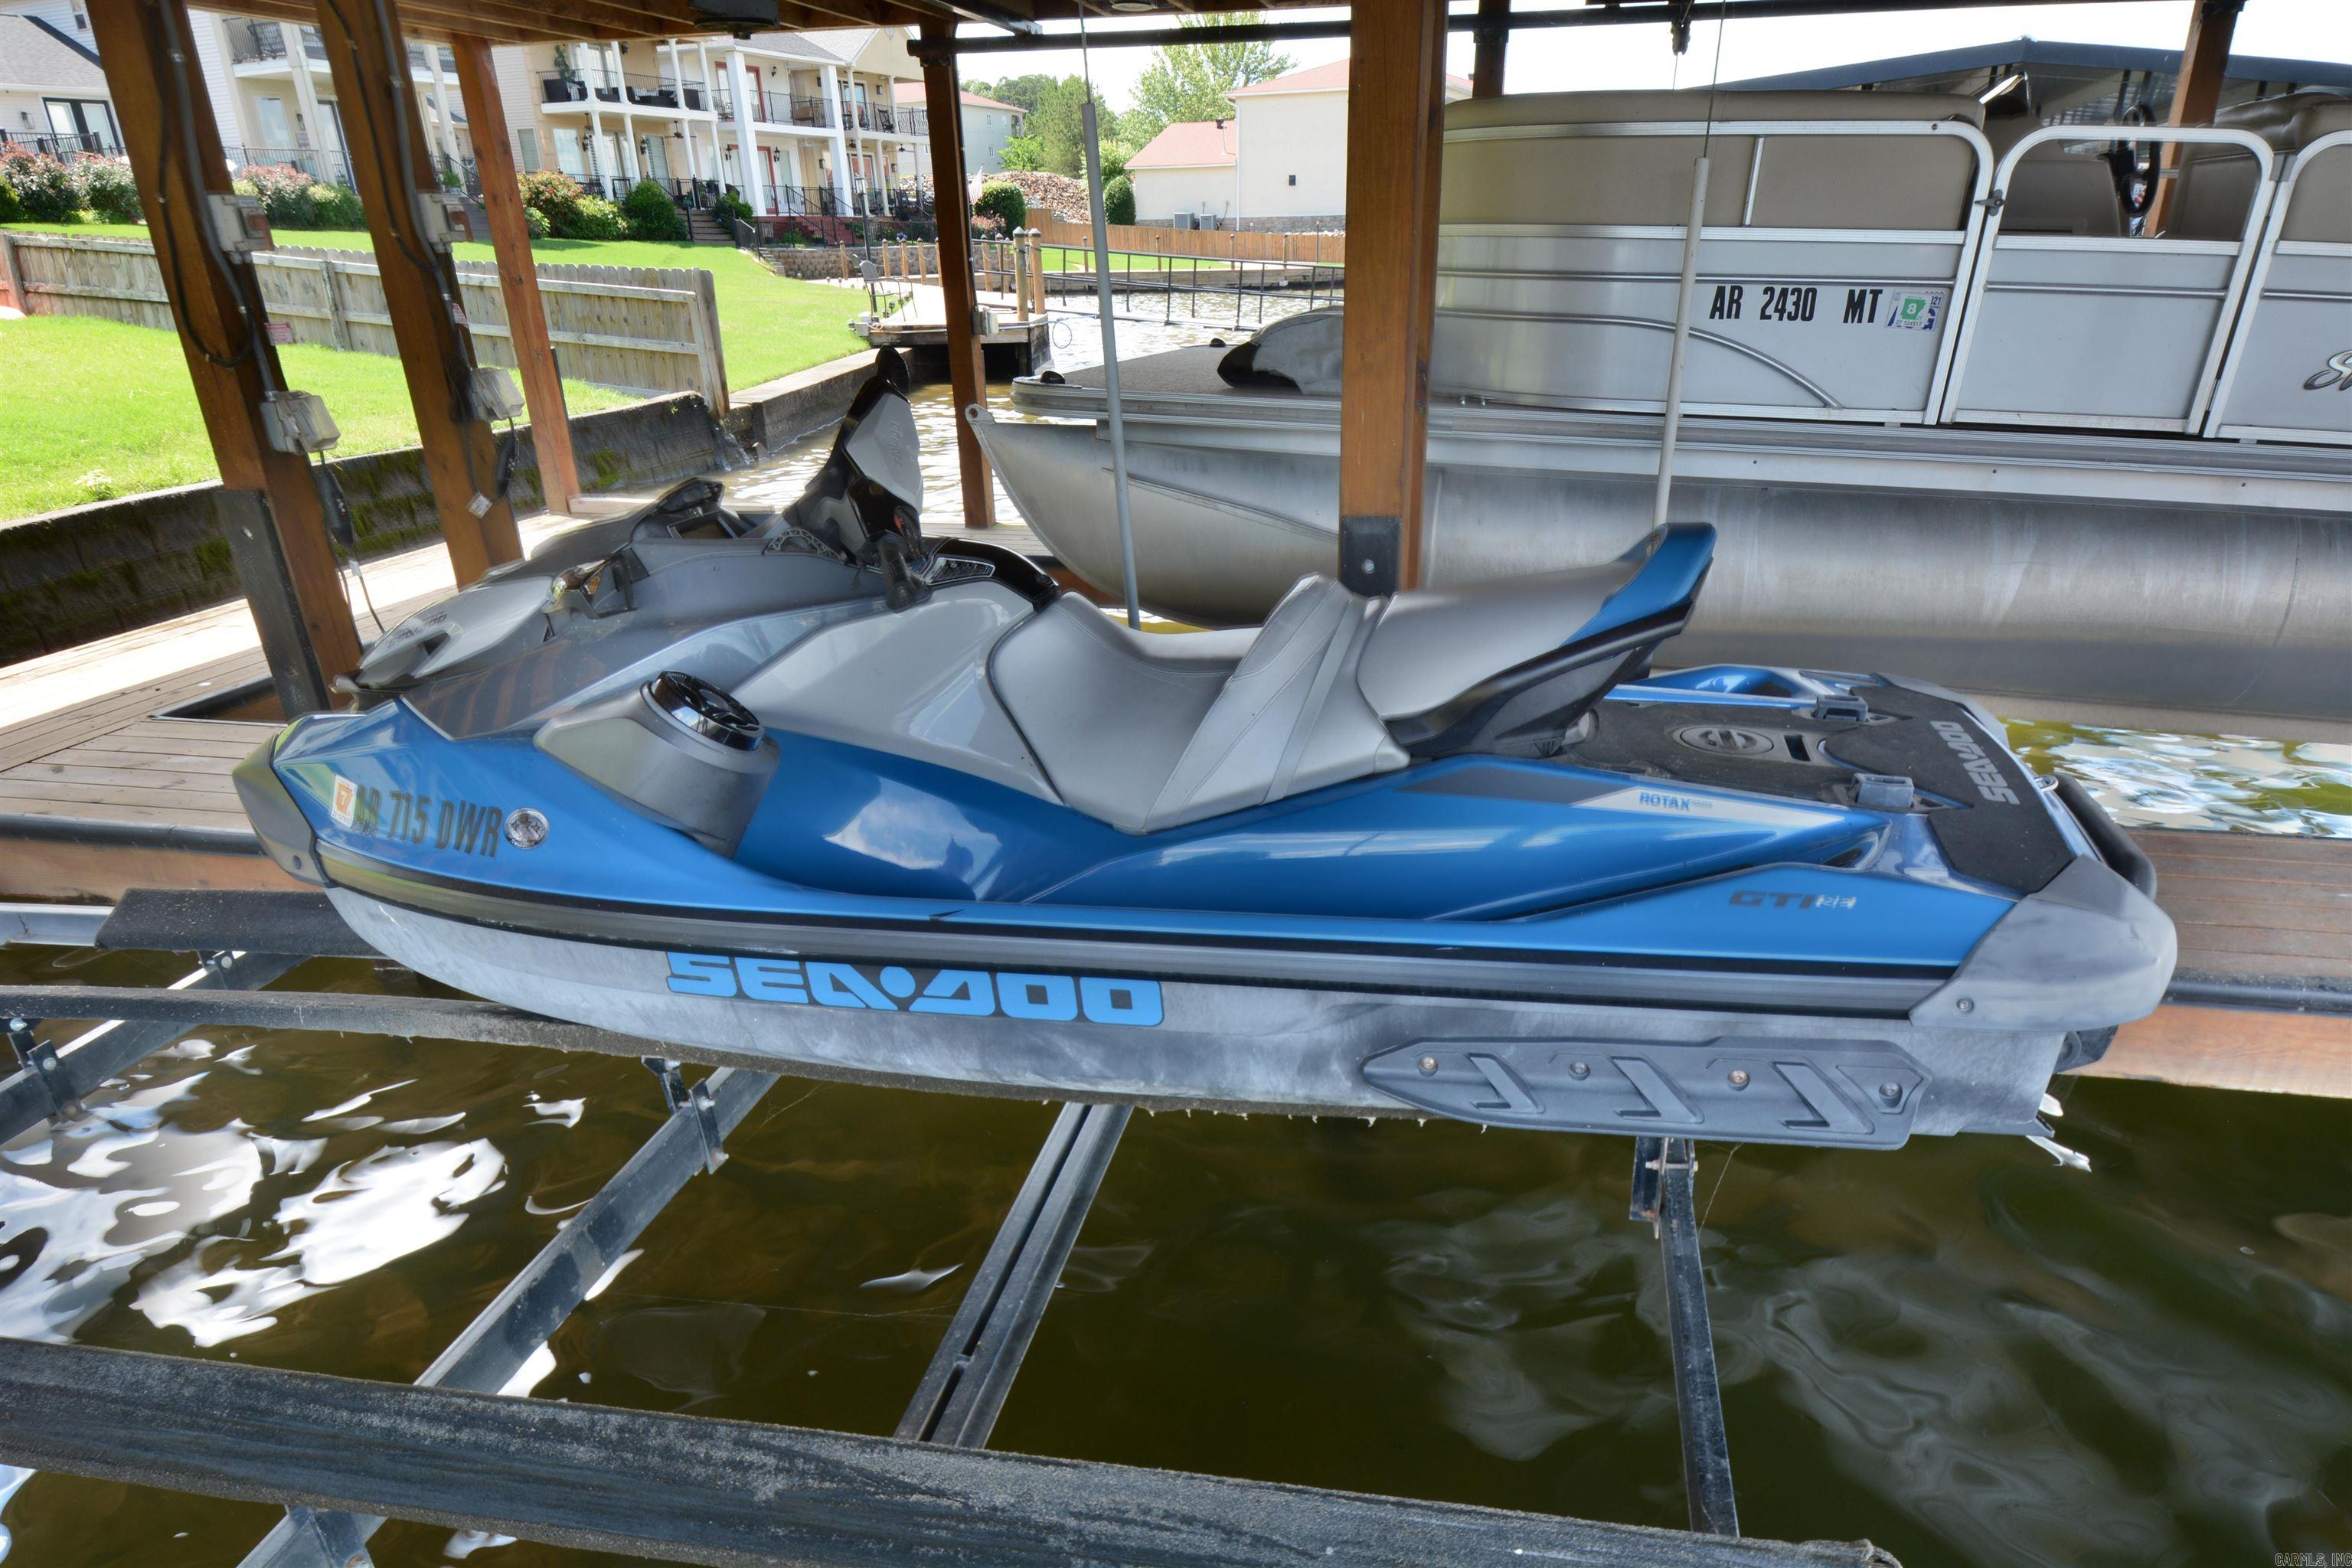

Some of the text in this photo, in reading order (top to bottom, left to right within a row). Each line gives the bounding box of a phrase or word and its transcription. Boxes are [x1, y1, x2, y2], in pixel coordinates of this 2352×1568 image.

[1709, 285, 1743, 319] AR
[1759, 286, 1817, 322] 2430
[1843, 289, 1883, 323] MT
[1906, 302, 1917, 315] 8
[341, 790, 348, 806] 7
[1640, 792, 1690, 812] ROTAX
[387, 791, 430, 844] 715
[435, 800, 503, 858] DWR
